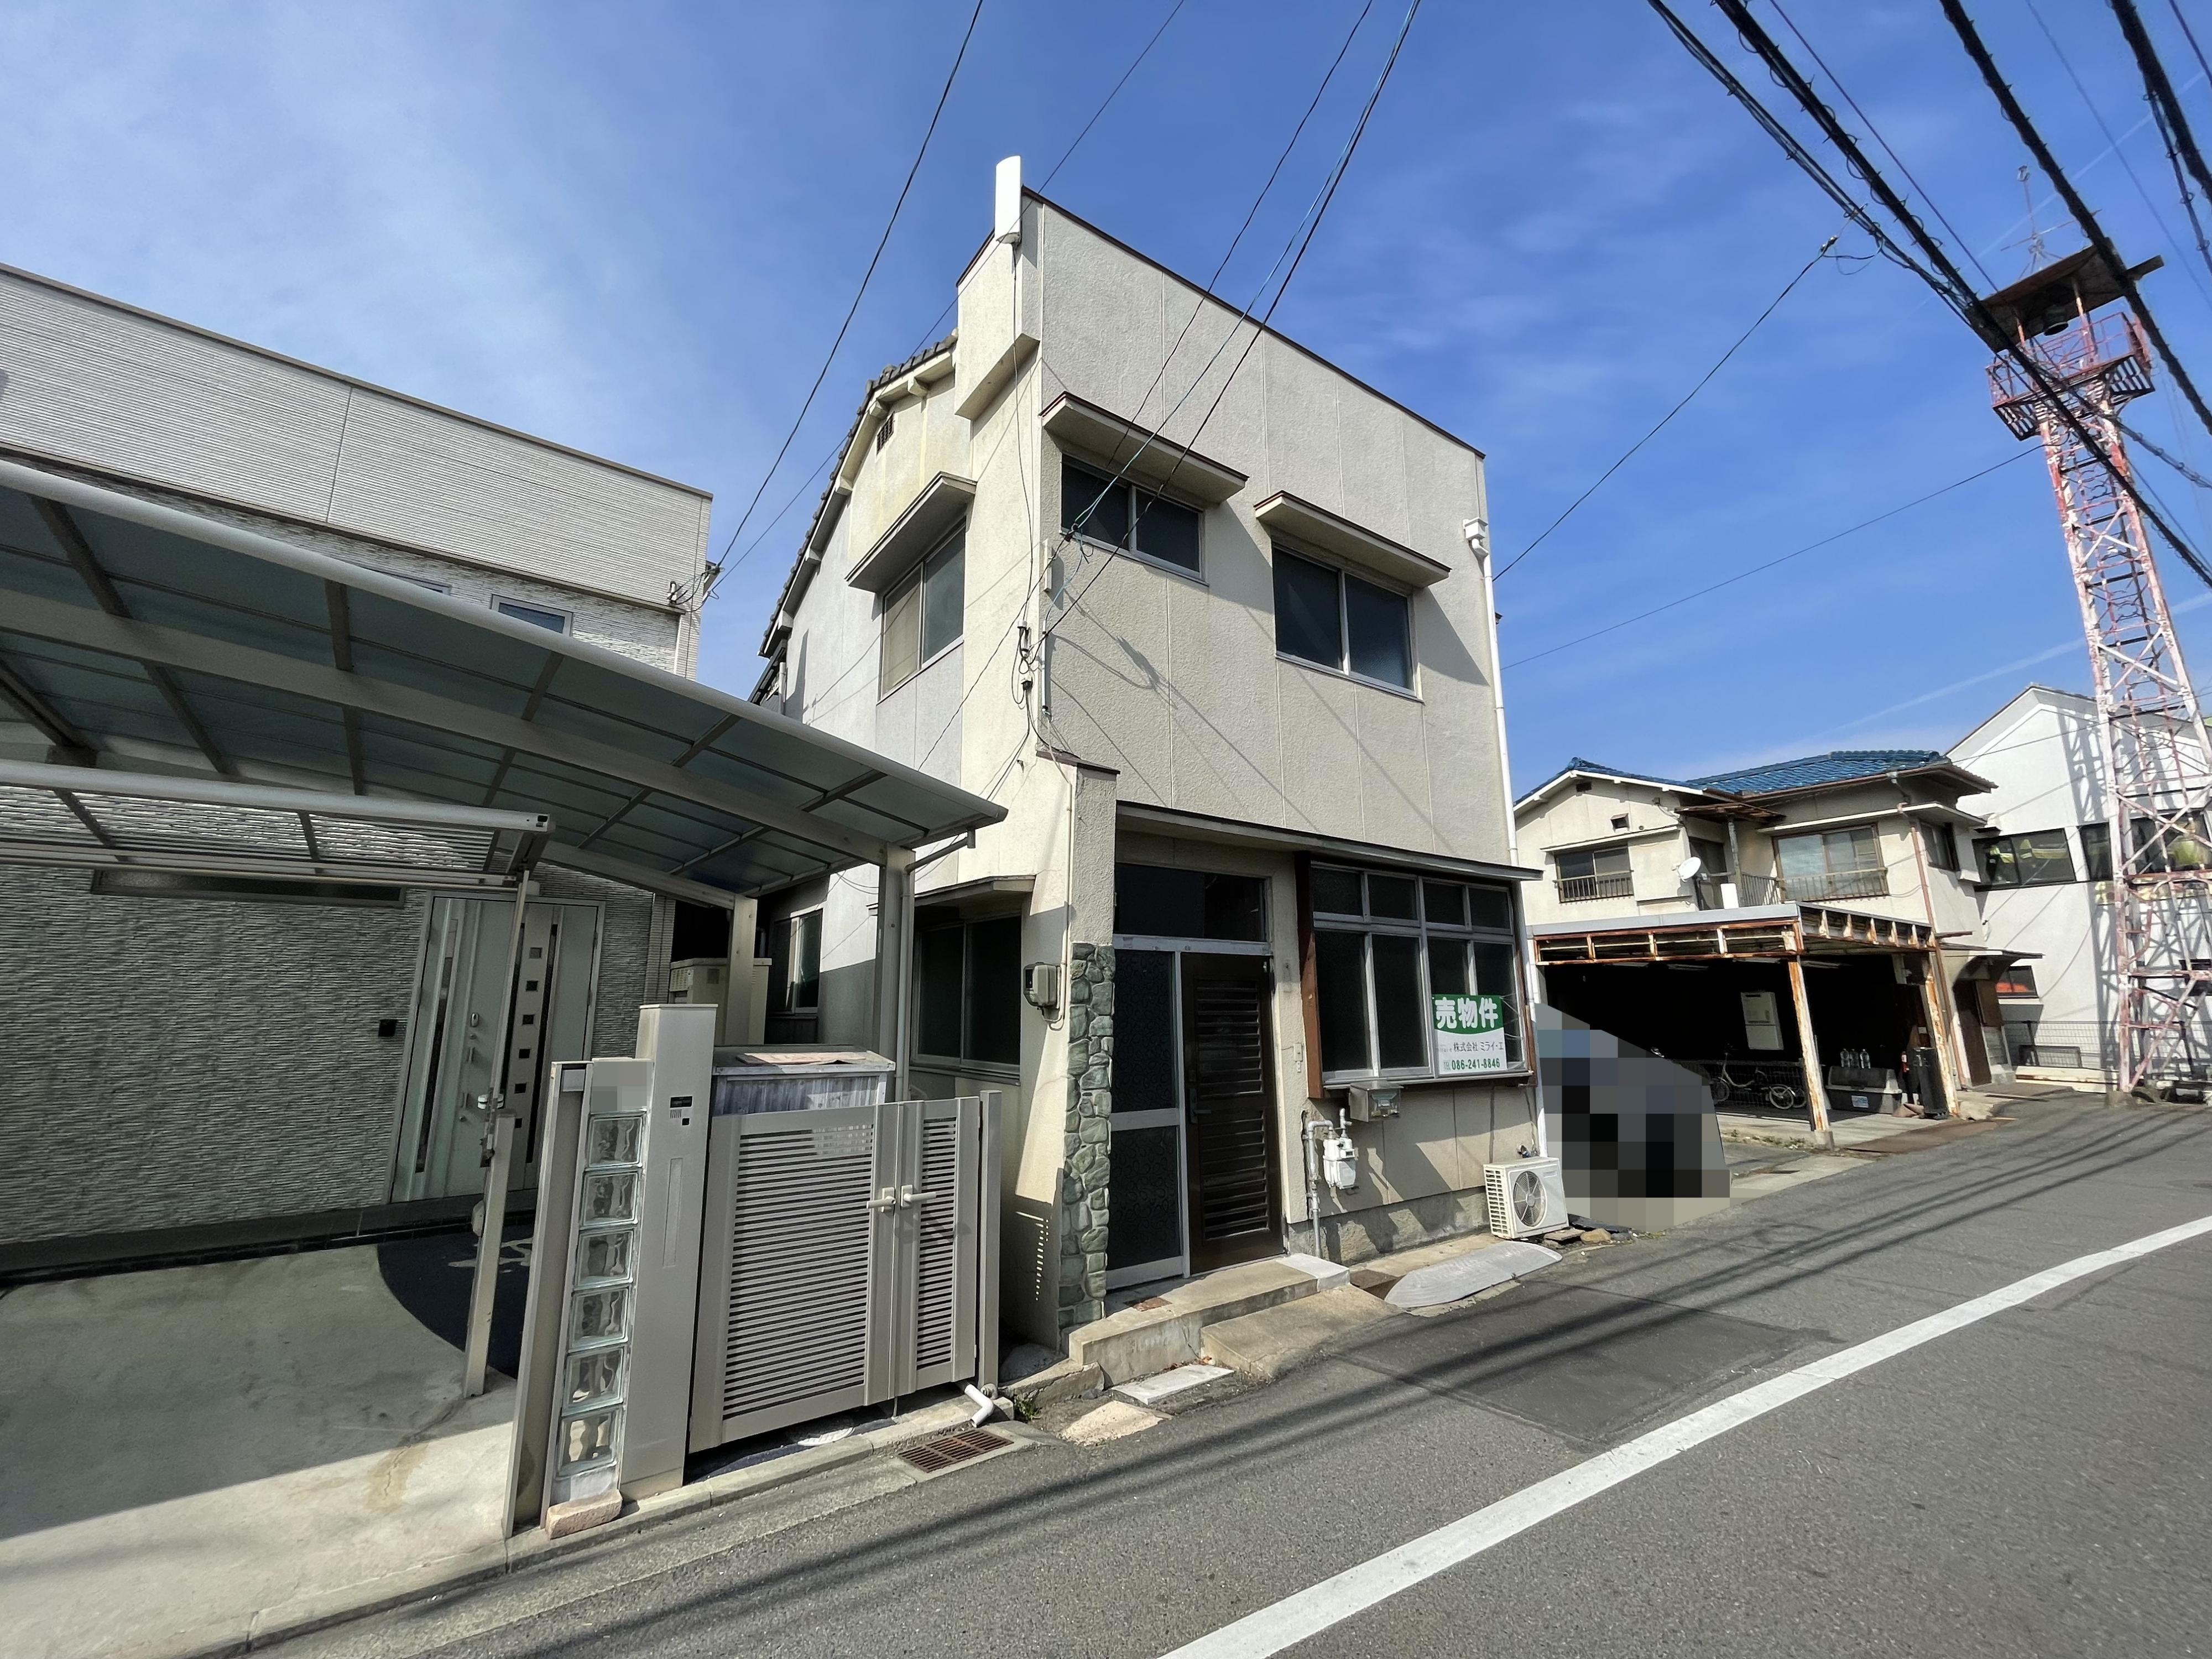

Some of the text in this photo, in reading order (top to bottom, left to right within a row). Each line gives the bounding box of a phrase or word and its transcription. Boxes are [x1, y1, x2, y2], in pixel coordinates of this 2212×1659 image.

[1434, 997, 1498, 1029] 売物件
[1452, 1058, 1500, 1070] 086-241-8846
